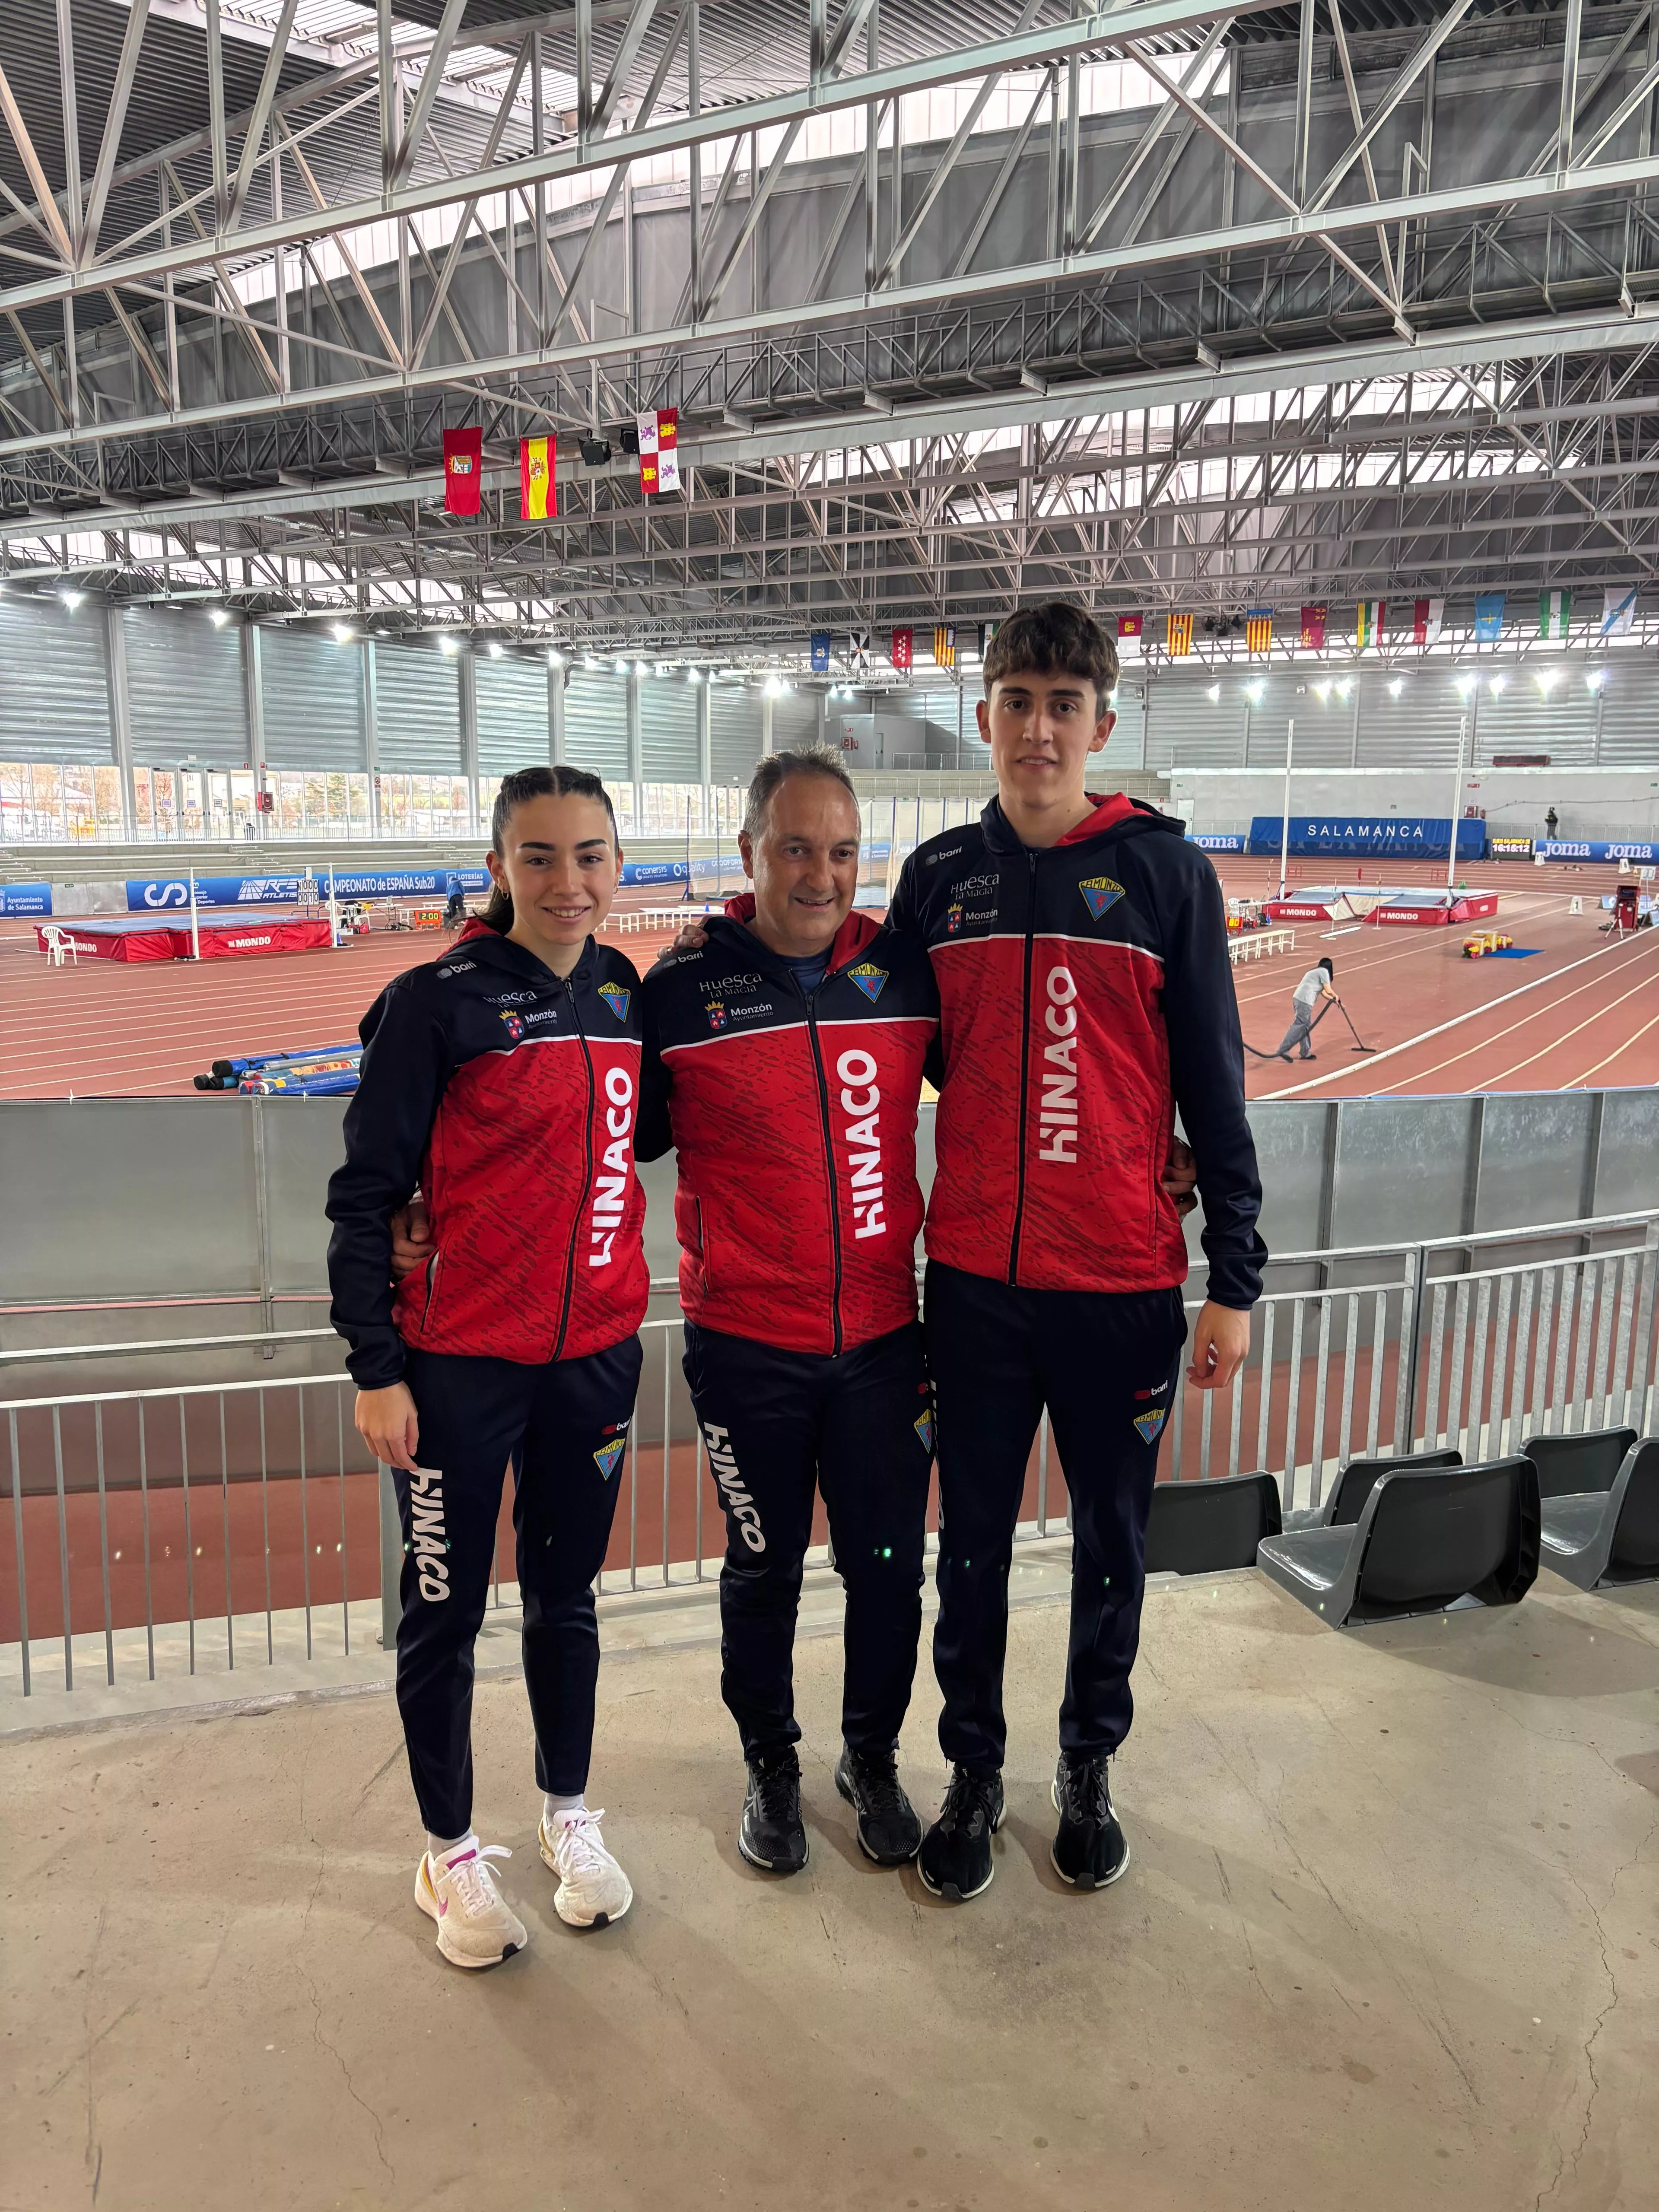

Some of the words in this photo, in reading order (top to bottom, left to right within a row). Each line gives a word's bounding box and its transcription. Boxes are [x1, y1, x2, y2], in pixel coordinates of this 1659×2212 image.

[1308, 825, 1423, 837] SALAMANCA
[939, 846, 963, 860] barri
[642, 865, 667, 874] conersys
[378, 878, 386, 890] de
[387, 874, 413, 890] ESPAÑA
[415, 876, 435, 889] Sub20
[951, 874, 999, 894] Huesca
[966, 909, 998, 921] Monzón
[1387, 912, 1418, 920] MONDO
[235, 936, 271, 947] MONDO
[678, 951, 703, 963] barri
[450, 961, 477, 974] barri
[699, 973, 763, 992] Huesca
[524, 1009, 557, 1024] Monzón
[730, 1003, 772, 1017] Monzón
[733, 1011, 773, 1021] Ayuntamiento
[1039, 966, 1077, 1163] HINACO
[836, 1049, 886, 1239] HINACO
[589, 1067, 632, 1266] HINACO
[1151, 1380, 1168, 1395] barri
[704, 1422, 766, 1552] HINACO
[409, 1467, 450, 1602] HINACO
